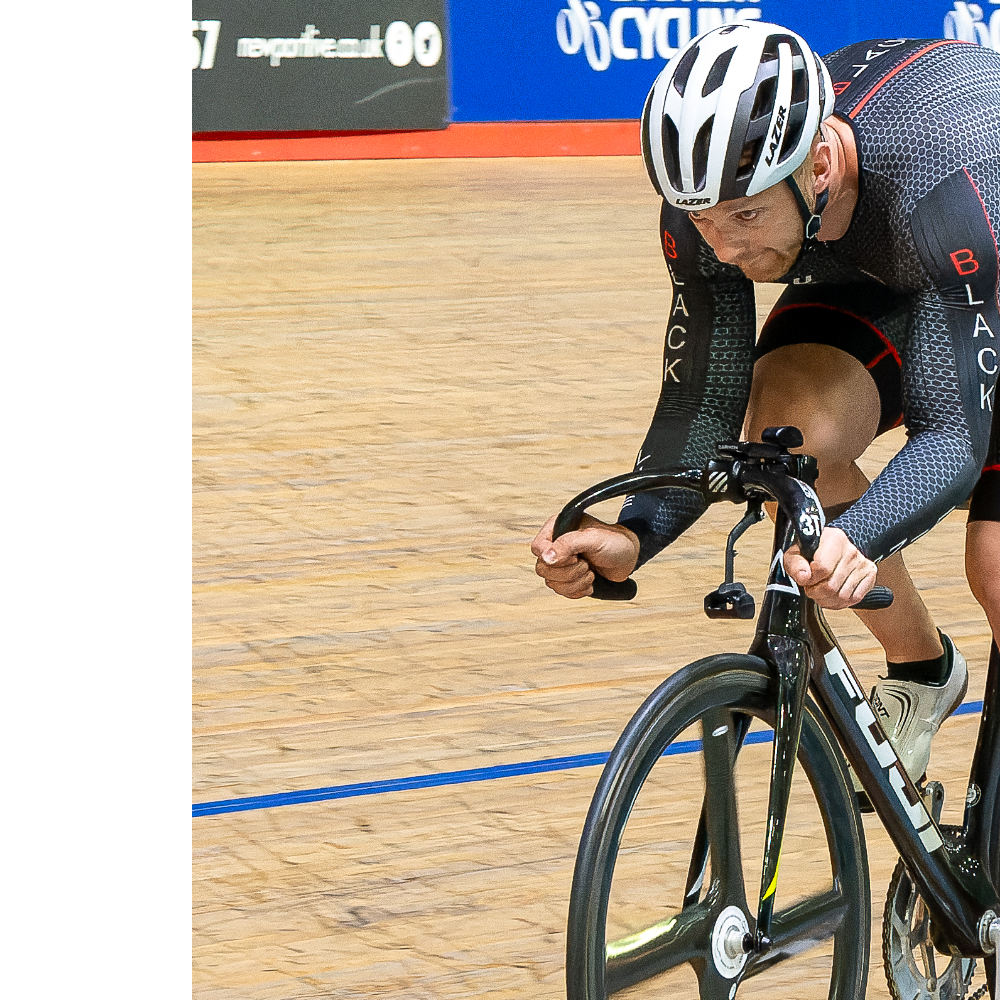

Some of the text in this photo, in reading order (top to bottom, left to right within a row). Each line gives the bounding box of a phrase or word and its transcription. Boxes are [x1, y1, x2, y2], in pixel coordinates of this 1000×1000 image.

[610, 7, 762, 60] CYCLI
[765, 105, 787, 167] LAZER
[676, 197, 711, 205] LAZER
[663, 231, 690, 383] BLACK
[949, 248, 998, 412] BLACK
